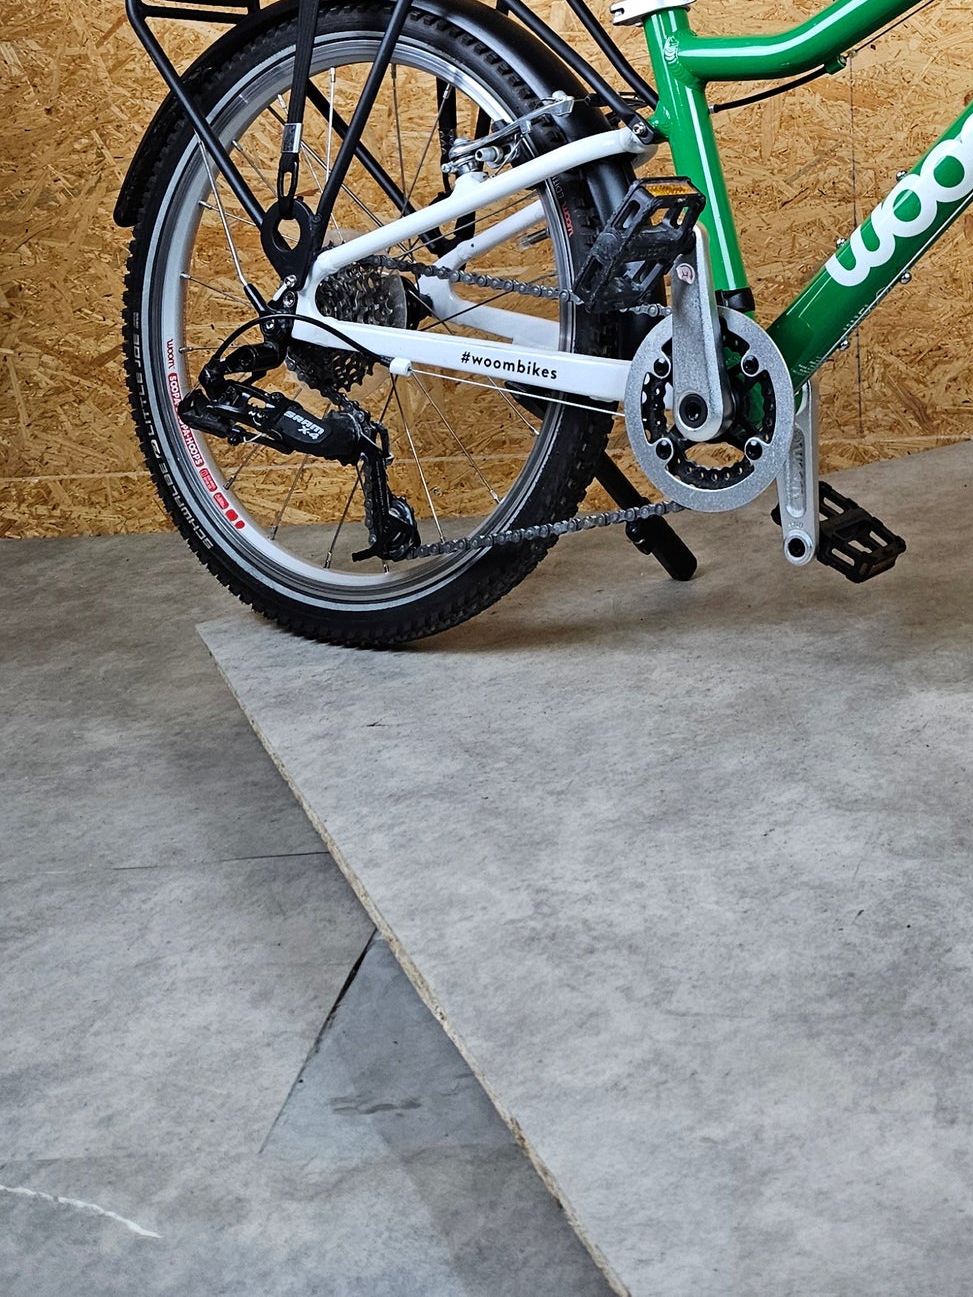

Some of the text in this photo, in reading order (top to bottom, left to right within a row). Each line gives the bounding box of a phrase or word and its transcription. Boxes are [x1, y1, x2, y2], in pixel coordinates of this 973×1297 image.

[133, 333, 141, 368] JOE
[166, 338, 175, 369] woom
[461, 351, 557, 380] #woombikes
[136, 372, 155, 436] LITTLE
[283, 410, 325, 435] SRAM
[159, 462, 214, 549] SCHWALBE
